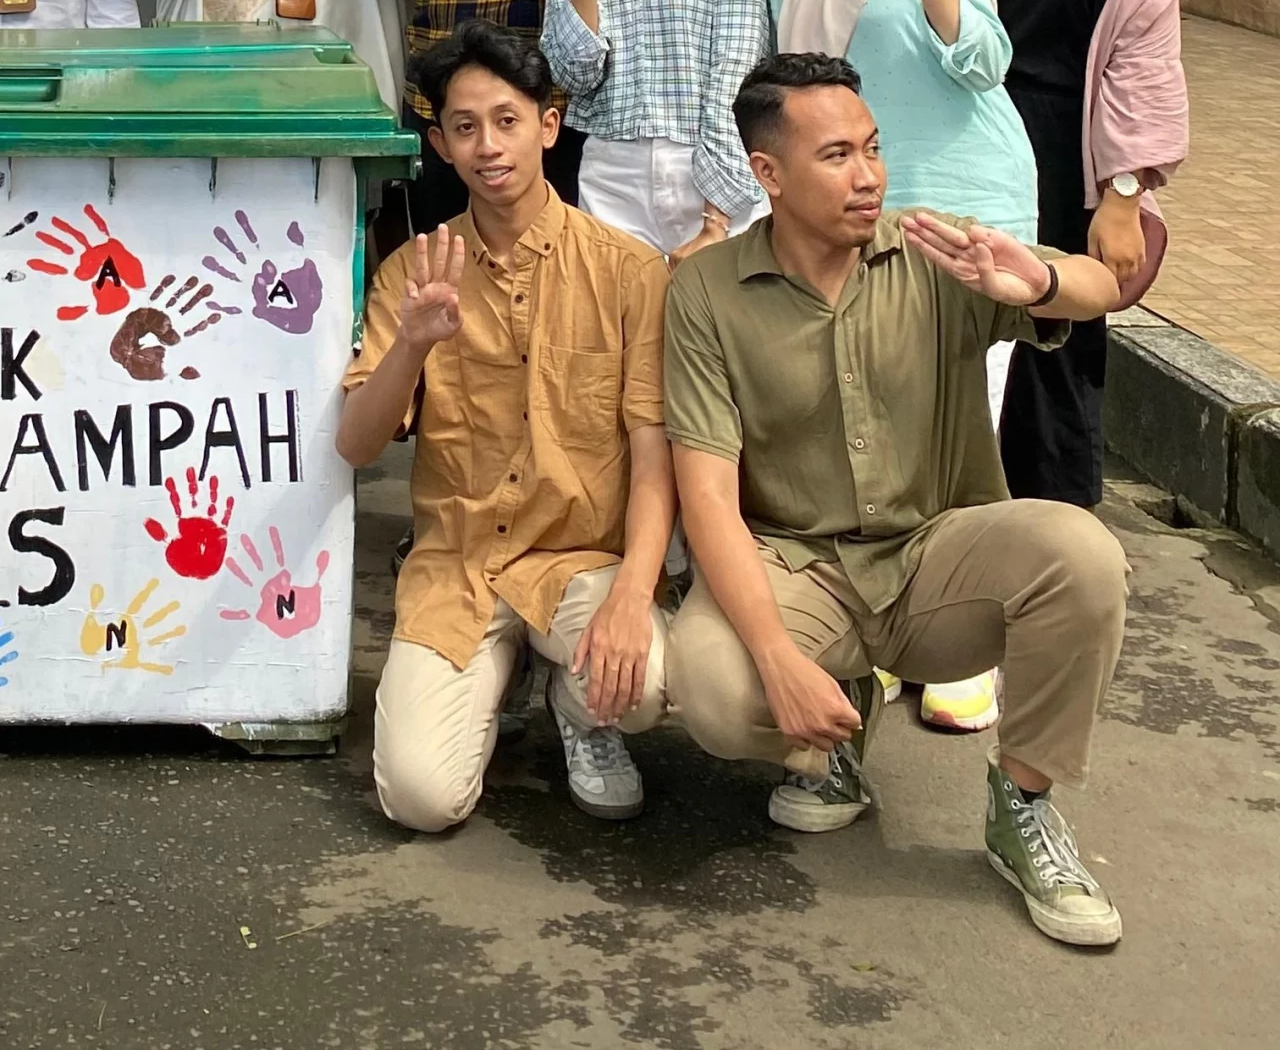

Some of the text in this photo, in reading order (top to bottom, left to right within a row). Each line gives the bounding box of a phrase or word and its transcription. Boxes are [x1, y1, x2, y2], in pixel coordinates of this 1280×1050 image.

[96, 256, 121, 290] A
[268, 279, 293, 304] A
[276, 590, 295, 620] N
[106, 620, 127, 651] N
